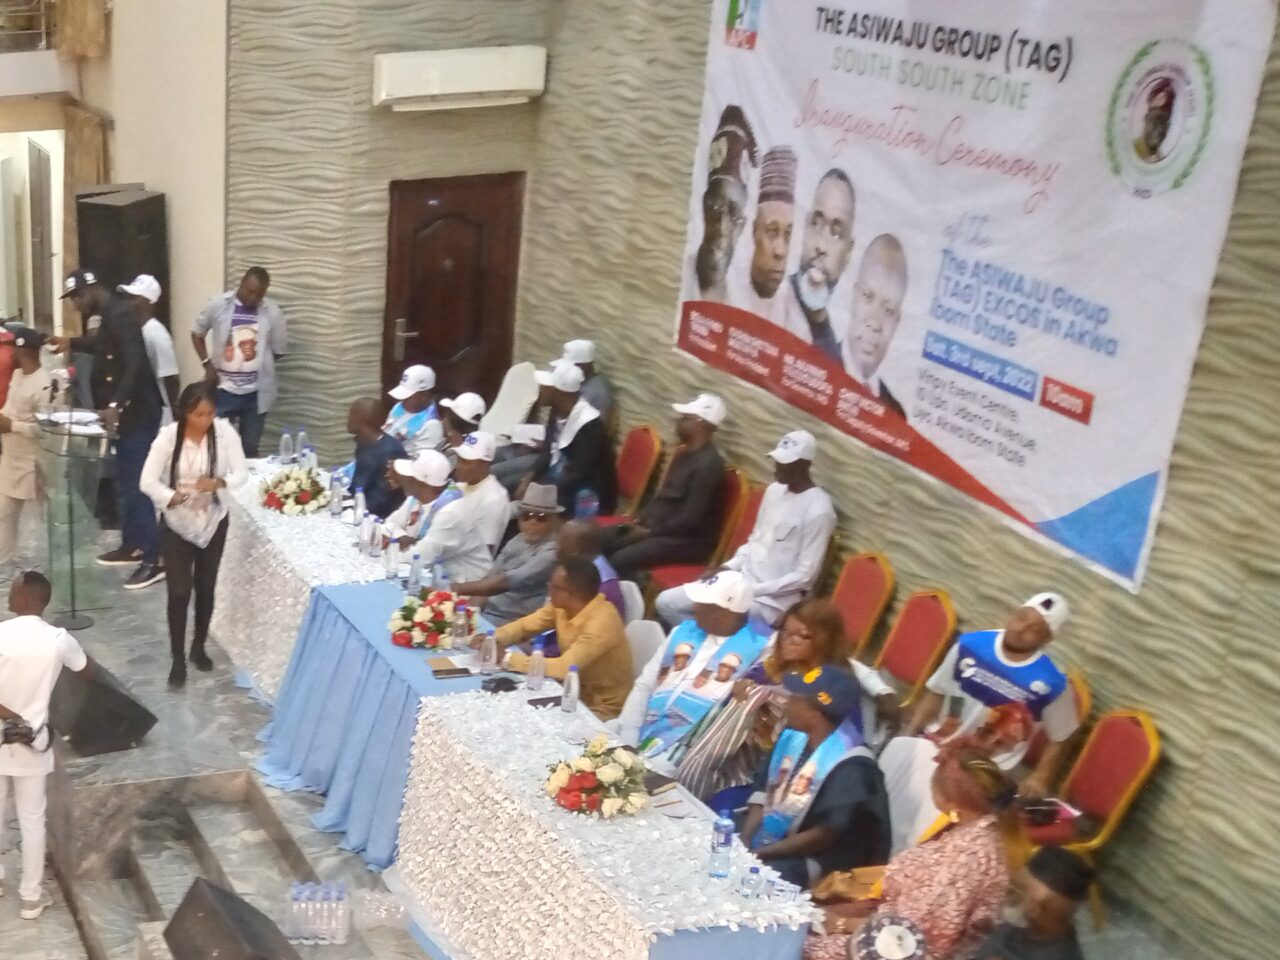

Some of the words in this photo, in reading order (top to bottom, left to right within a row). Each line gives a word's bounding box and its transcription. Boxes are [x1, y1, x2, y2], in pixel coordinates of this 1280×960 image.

[816, 6, 845, 36] THE
[847, 11, 930, 50] ASIWAJU
[932, 25, 1003, 62] GROUP
[1004, 28, 1074, 84] (TAG)
[831, 46, 893, 82] SOUTH
[896, 58, 967, 96] SOUTH
[971, 72, 1034, 111] ZONE
[934, 114, 1062, 215] Ceremony
[934, 272, 983, 314] (TAG)
[983, 290, 1041, 329] EXCOS
[1042, 309, 1062, 335] in
[1063, 319, 1119, 358] Akwa
[941, 248, 969, 277] The
[970, 260, 1051, 304] ASIWAJU
[1051, 286, 1111, 328] Group
[972, 312, 1018, 349] State
